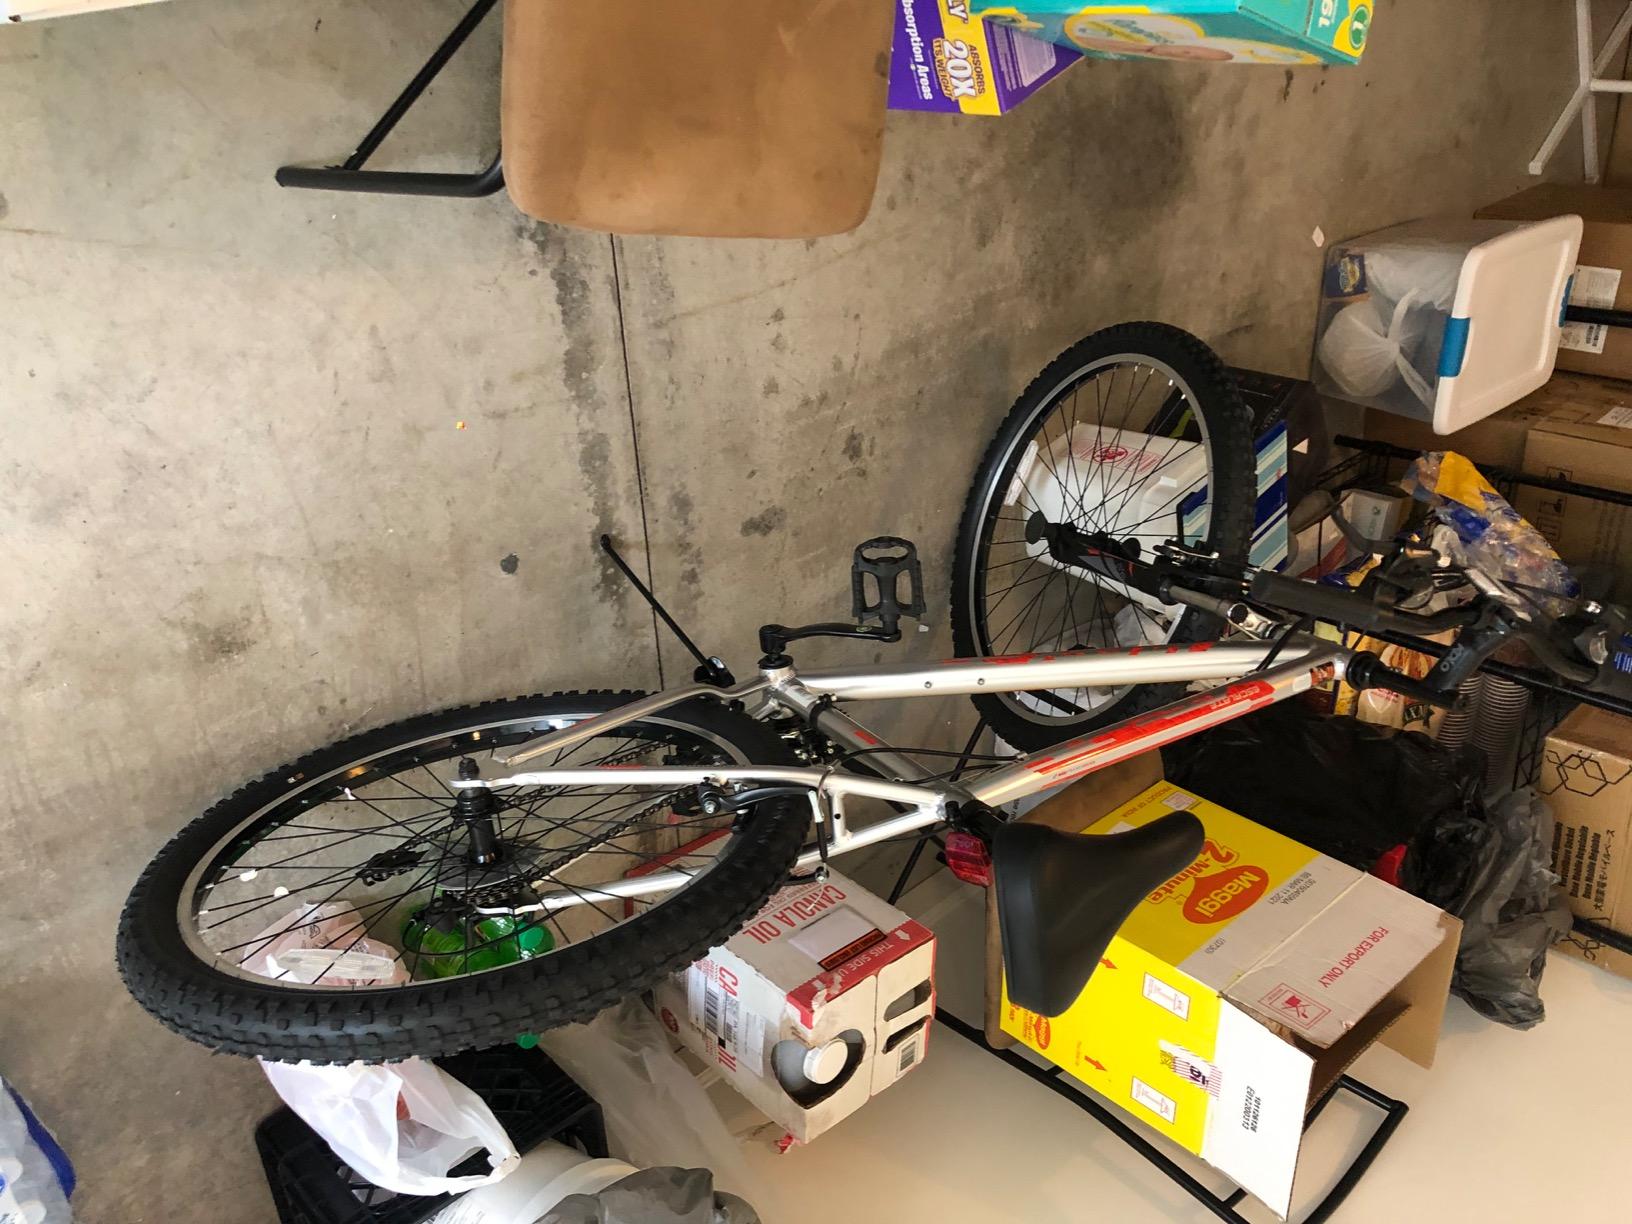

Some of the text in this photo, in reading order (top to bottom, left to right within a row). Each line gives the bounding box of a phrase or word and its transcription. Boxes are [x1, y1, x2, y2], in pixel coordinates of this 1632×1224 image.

[916, 63, 934, 101] Areas
[933, 39, 951, 98] ITS WEIGHT
[942, 39, 978, 98] 20X
[967, 44, 986, 95] ABSORBS
[773, 884, 847, 928] CANOLA
[1195, 870, 1262, 918] Maggi
[742, 920, 781, 945] OIL
[869, 941, 895, 957] THIS
[847, 953, 872, 971] SIDE
[1317, 926, 1389, 988] FOR EXPORT ONLY
